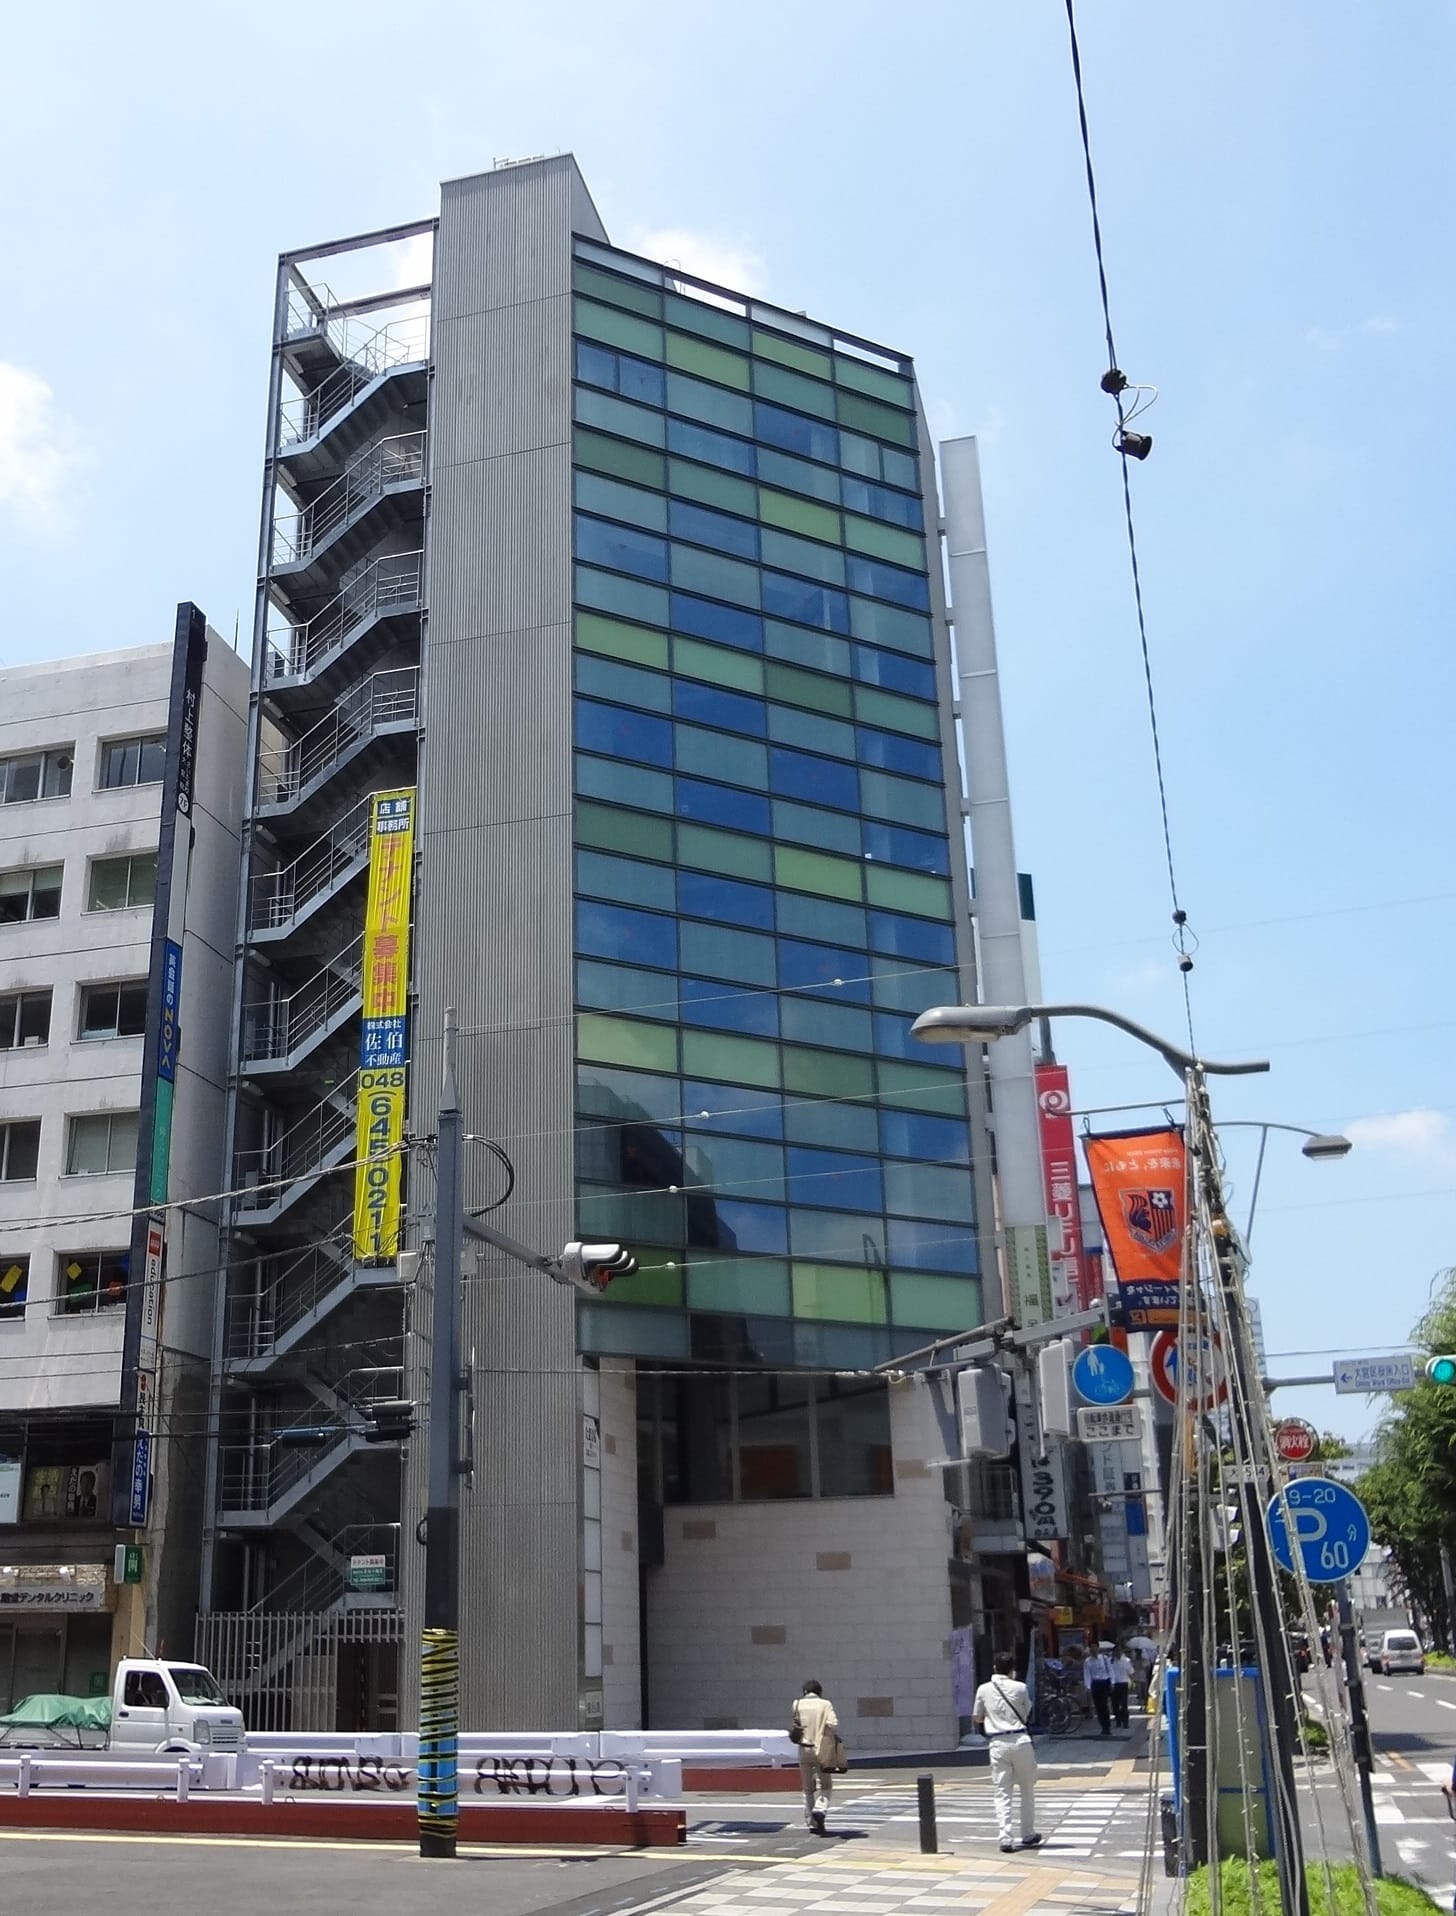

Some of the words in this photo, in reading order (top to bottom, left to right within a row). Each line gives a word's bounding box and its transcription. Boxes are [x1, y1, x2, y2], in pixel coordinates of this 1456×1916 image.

[380, 800, 408, 815] 店舗
[377, 817, 410, 833] 事務所
[373, 838, 402, 1014] テナント募集中
[367, 1019, 402, 1030] 株式会社
[366, 1032, 403, 1051] 佐伯
[366, 1052, 401, 1066] 不動産
[361, 1072, 404, 1089] 048
[1086, 1424, 1135, 1438] ここまで
[1279, 1434, 1310, 1449] 消火栓
[1289, 1488, 1336, 1505] 9-20
[1287, 1508, 1328, 1557] P
[1321, 1541, 1349, 1569] 60
